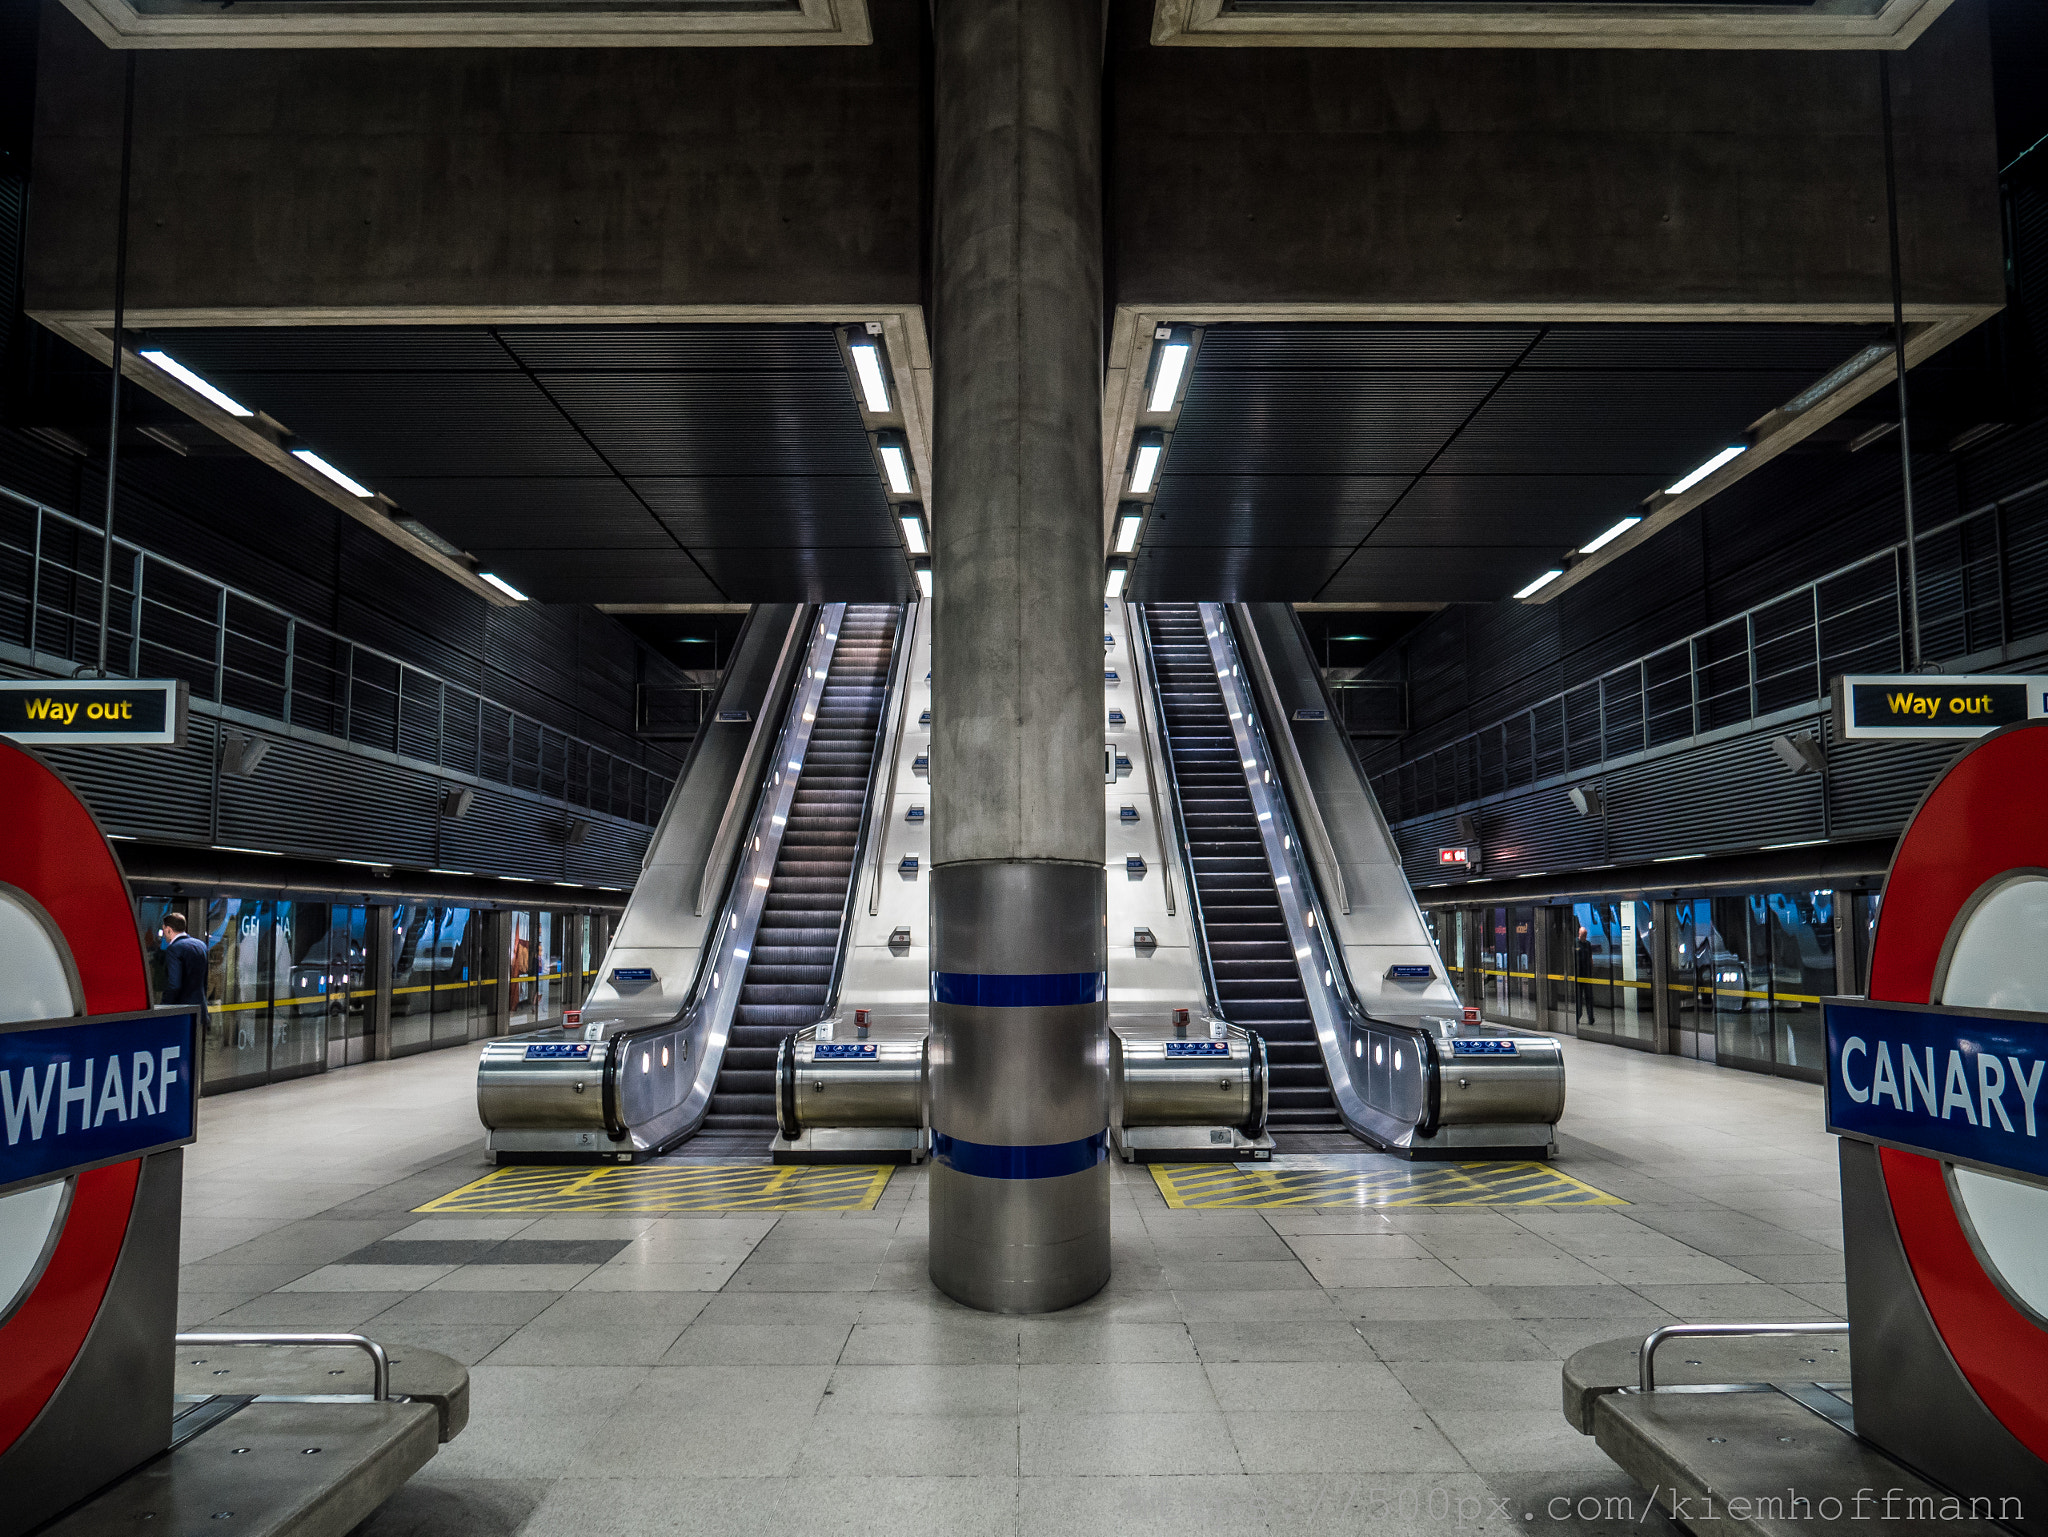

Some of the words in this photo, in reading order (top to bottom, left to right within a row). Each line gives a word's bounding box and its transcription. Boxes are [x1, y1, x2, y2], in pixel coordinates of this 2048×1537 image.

[24, 697, 79, 725] Way
[86, 699, 133, 720] out
[1886, 692, 1942, 719] Way
[1949, 694, 1994, 714] out
[0, 1045, 181, 1146] WHARF
[1841, 1035, 2046, 1138] CANARY
[582, 1133, 589, 1143] 5
